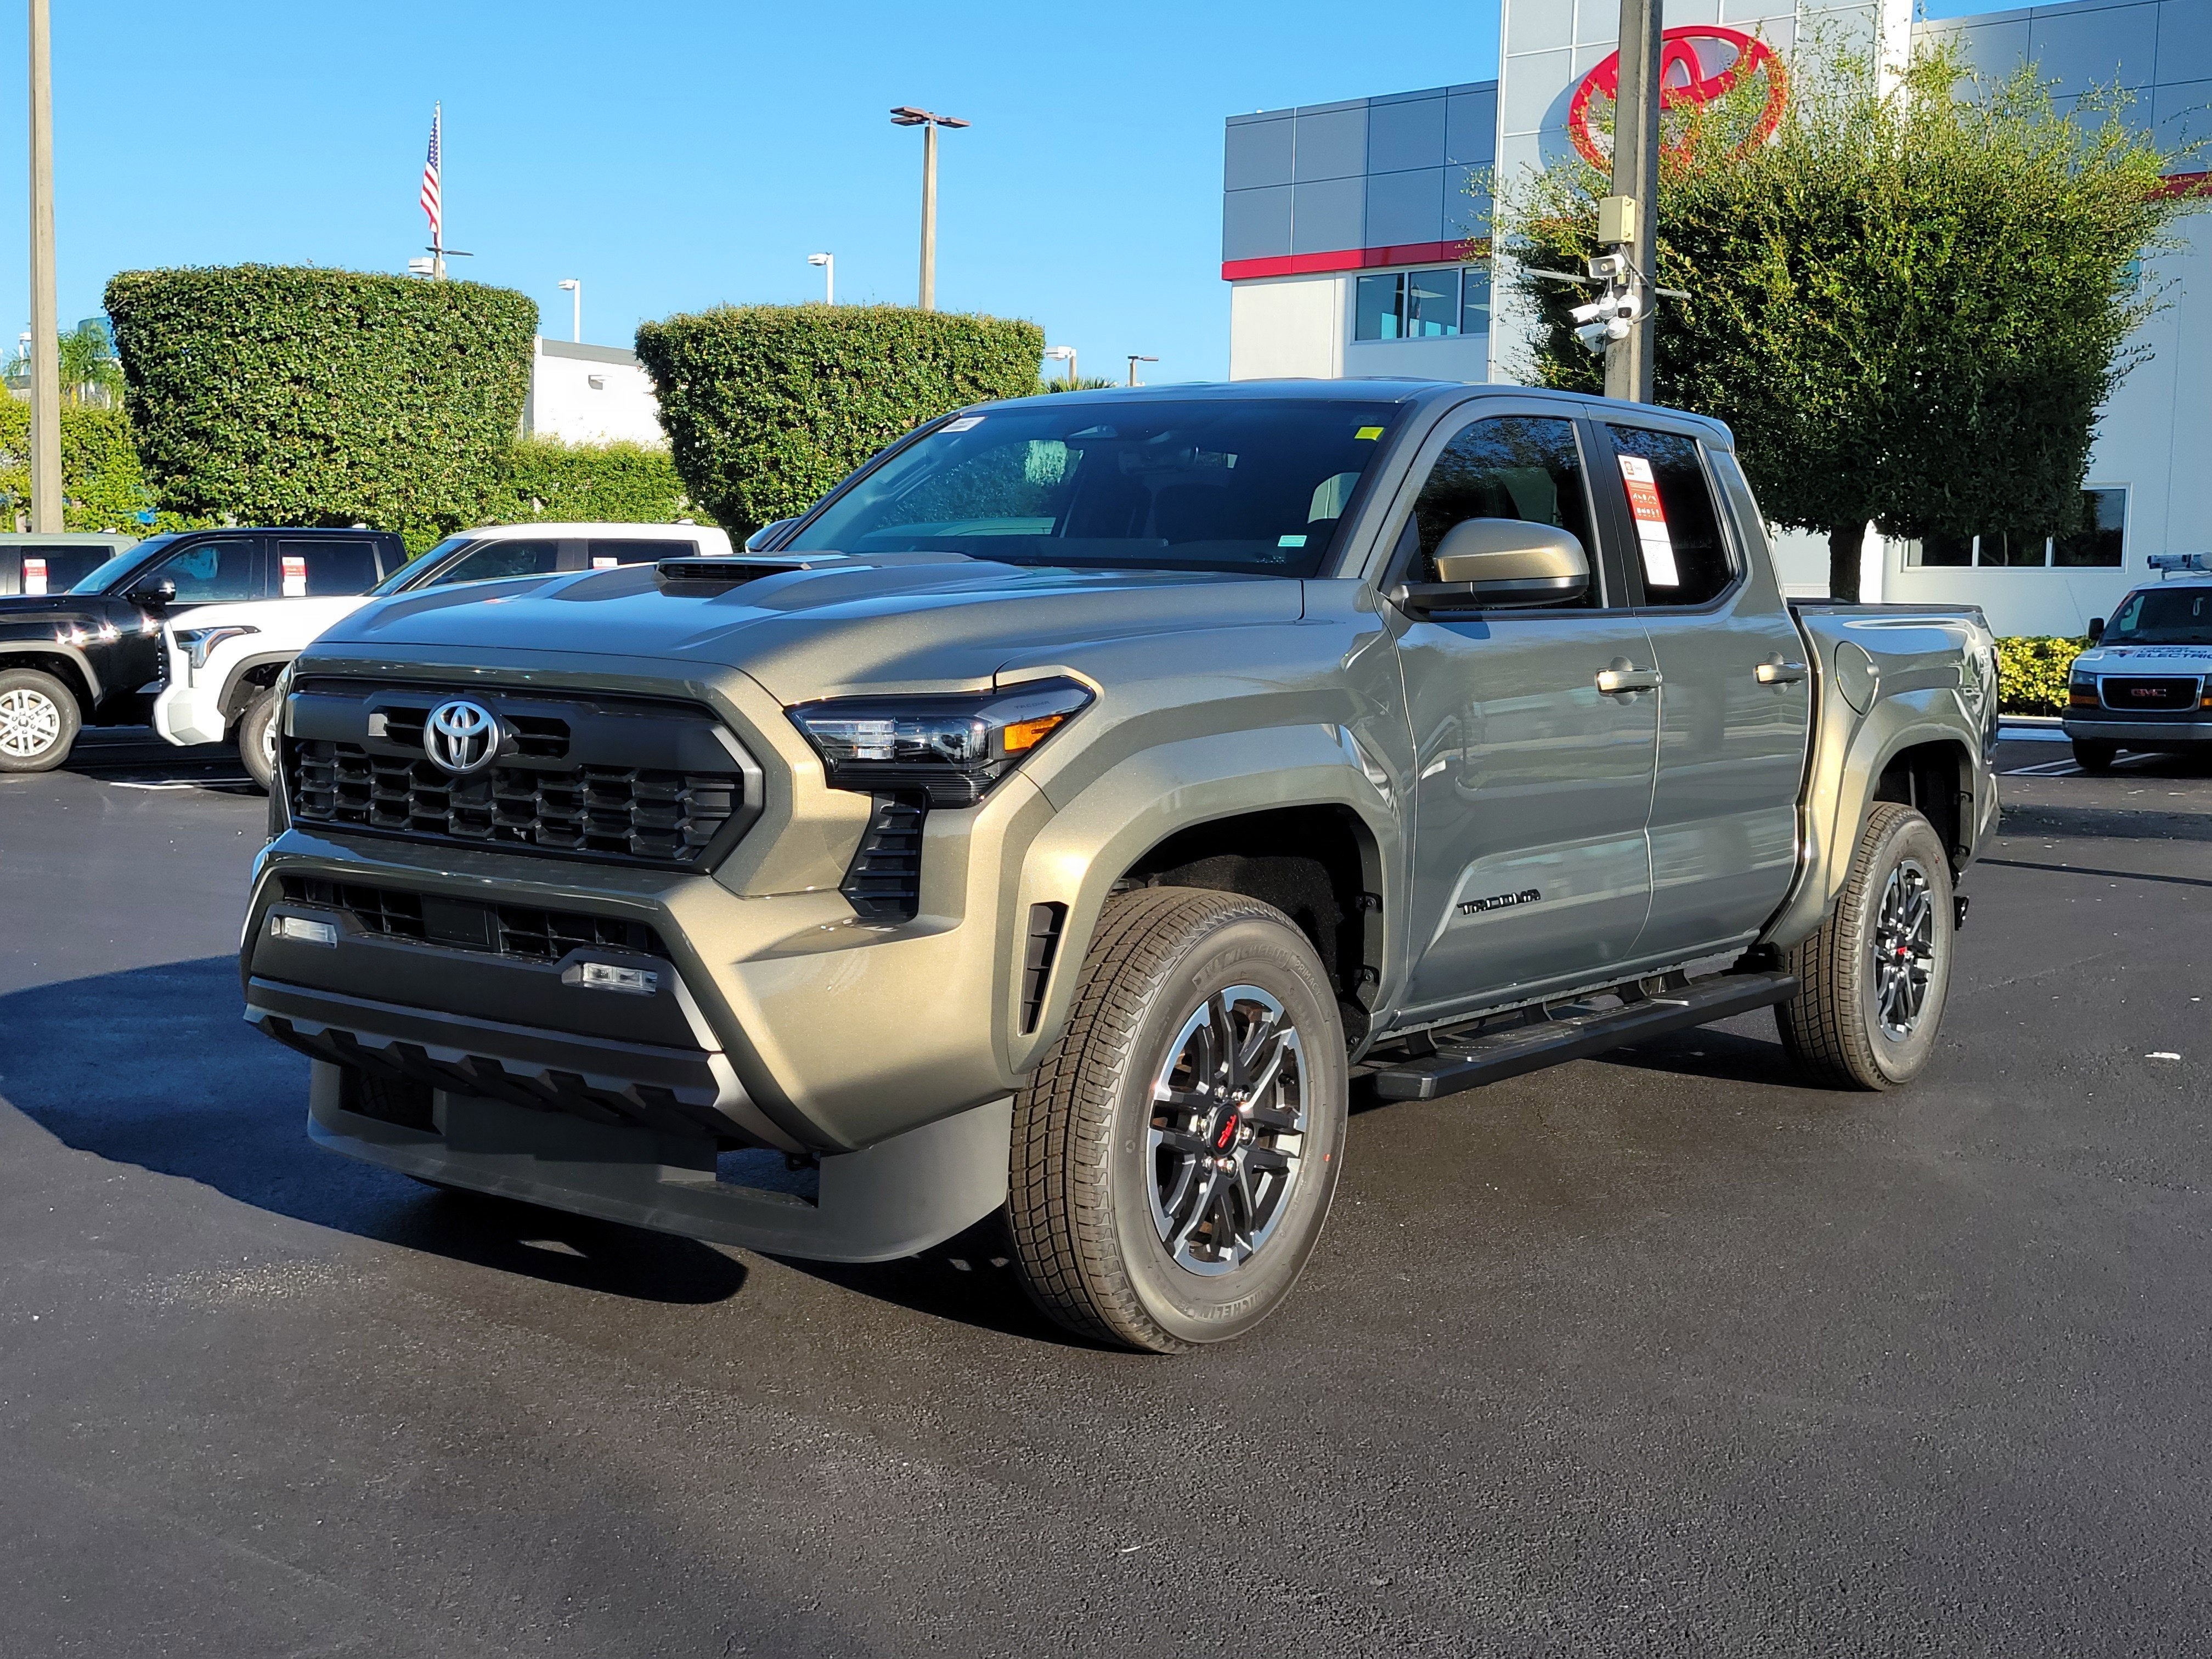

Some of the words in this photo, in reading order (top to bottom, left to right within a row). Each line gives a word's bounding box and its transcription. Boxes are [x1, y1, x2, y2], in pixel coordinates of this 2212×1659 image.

[1014, 701, 1051, 709] TACOMA
[2131, 689, 2166, 697] GMC
[1457, 889, 1541, 915] TACOMA
[1225, 944, 1288, 966] MICHELIN
[1295, 961, 1322, 996] PRIMACY
[1200, 1290, 1263, 1319] MICHELIN
